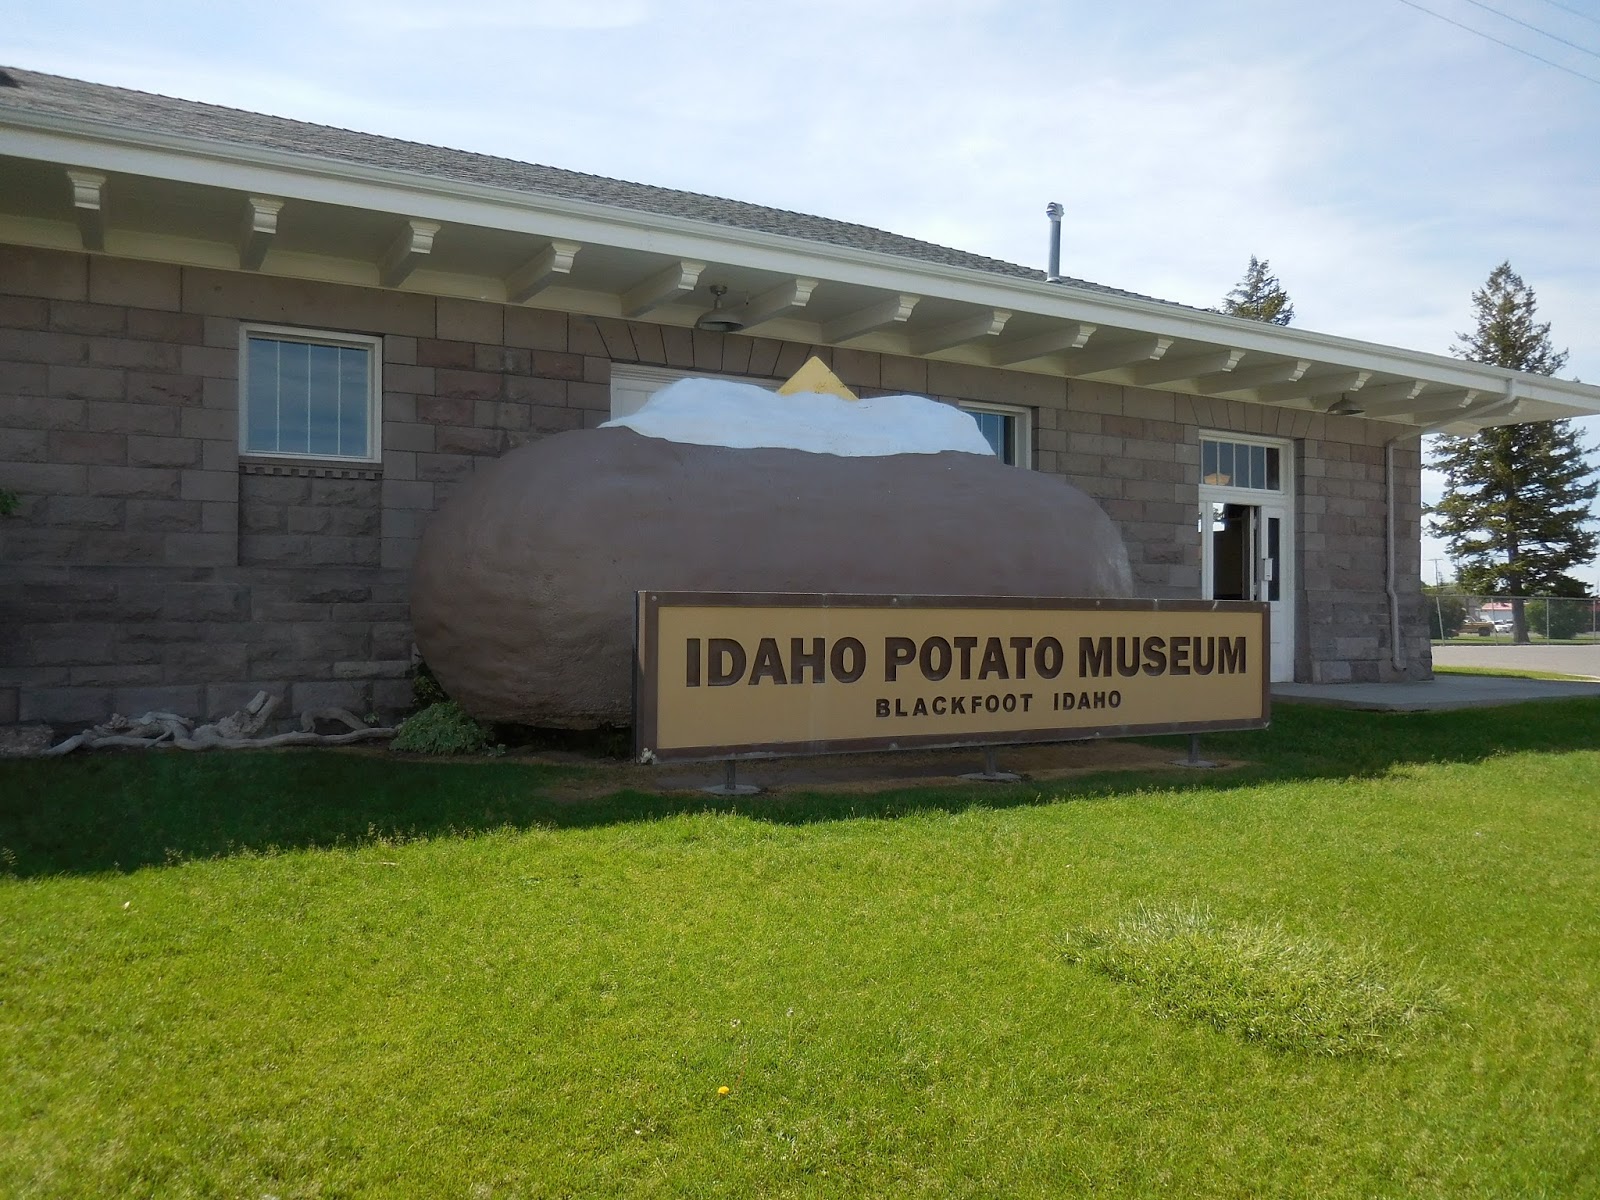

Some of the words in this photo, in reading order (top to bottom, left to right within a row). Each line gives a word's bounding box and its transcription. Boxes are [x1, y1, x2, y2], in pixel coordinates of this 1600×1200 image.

[686, 637, 866, 687] IDAHO
[885, 636, 1064, 682] POTATO
[1079, 636, 1246, 677] MUSEUM
[876, 694, 1033, 717] BLACKFOOT
[1054, 690, 1121, 711] IDAHO
